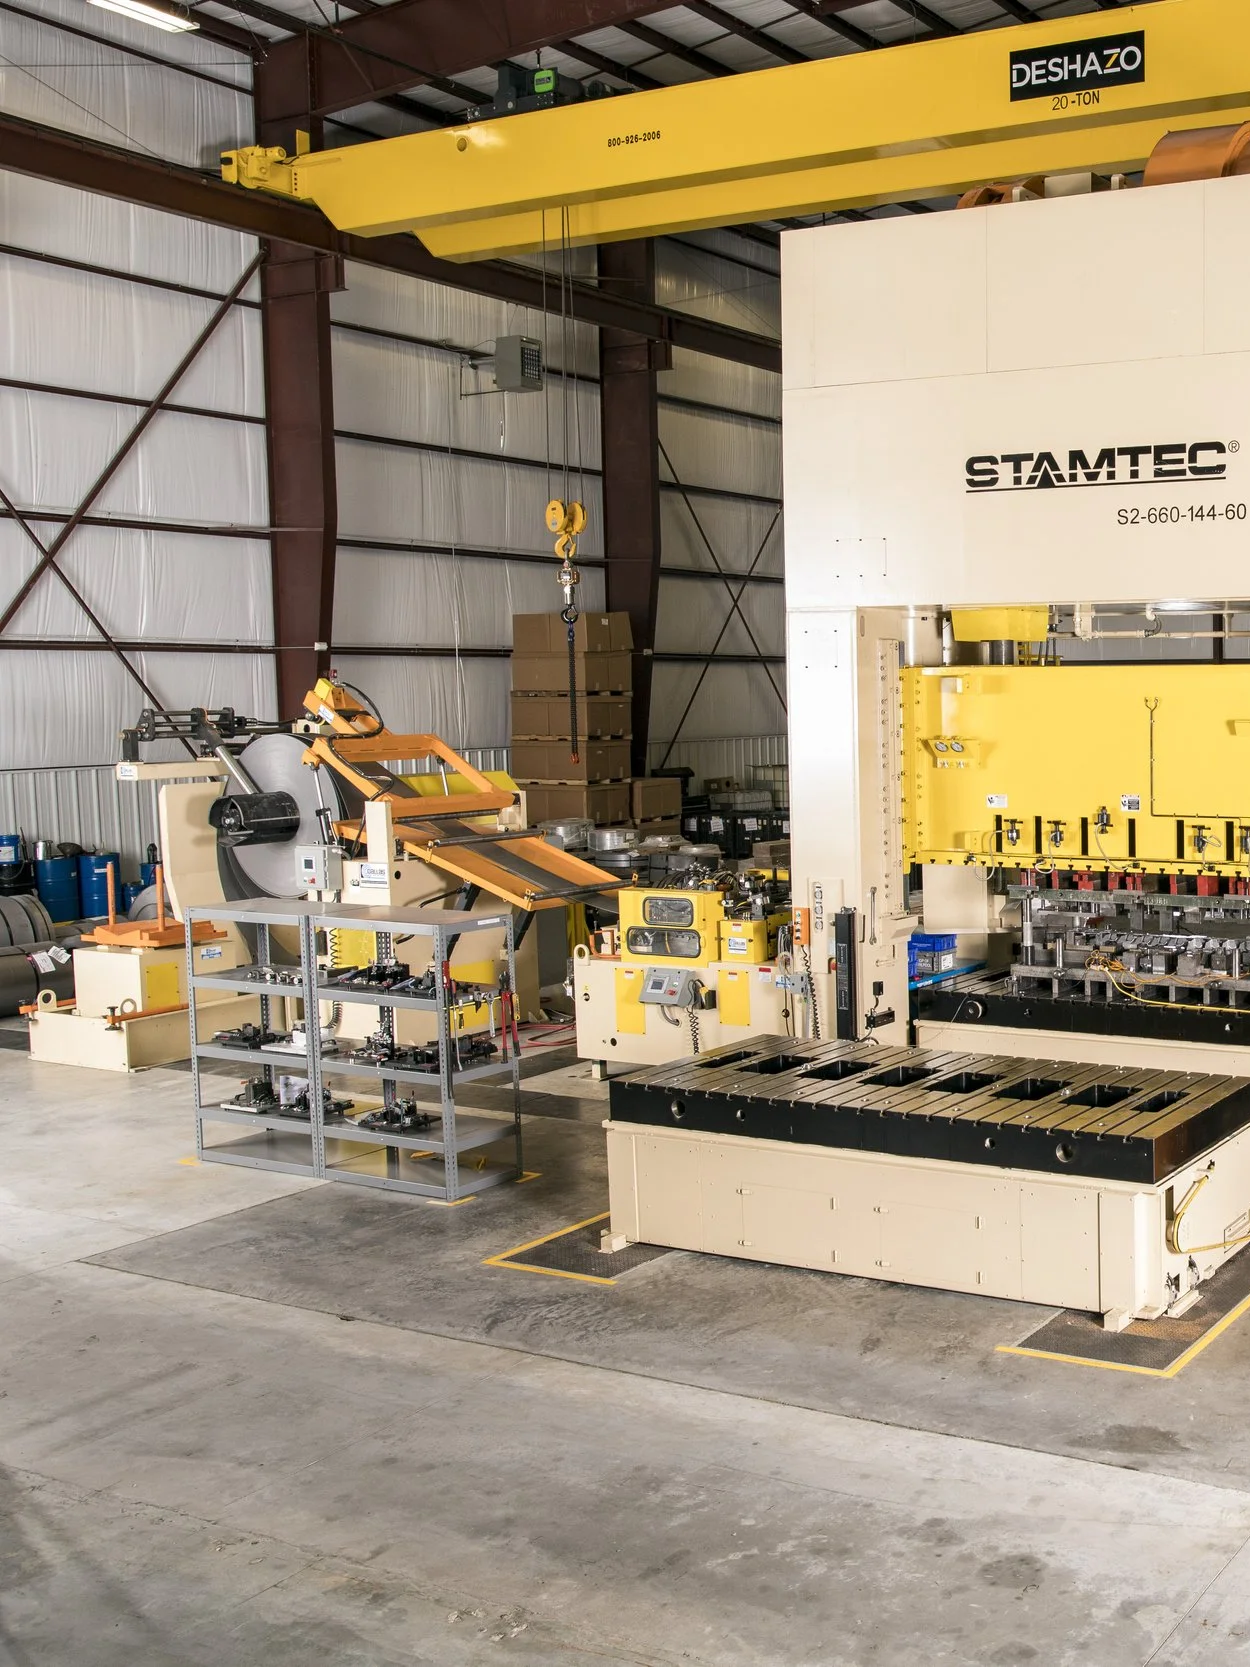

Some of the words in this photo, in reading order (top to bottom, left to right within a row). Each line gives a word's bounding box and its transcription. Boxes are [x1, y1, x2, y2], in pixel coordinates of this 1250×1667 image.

[1012, 45, 1142, 88] DESHAZO
[607, 130, 661, 148] 800-926-2006
[1117, 503, 1248, 526] S2-660-144-60
